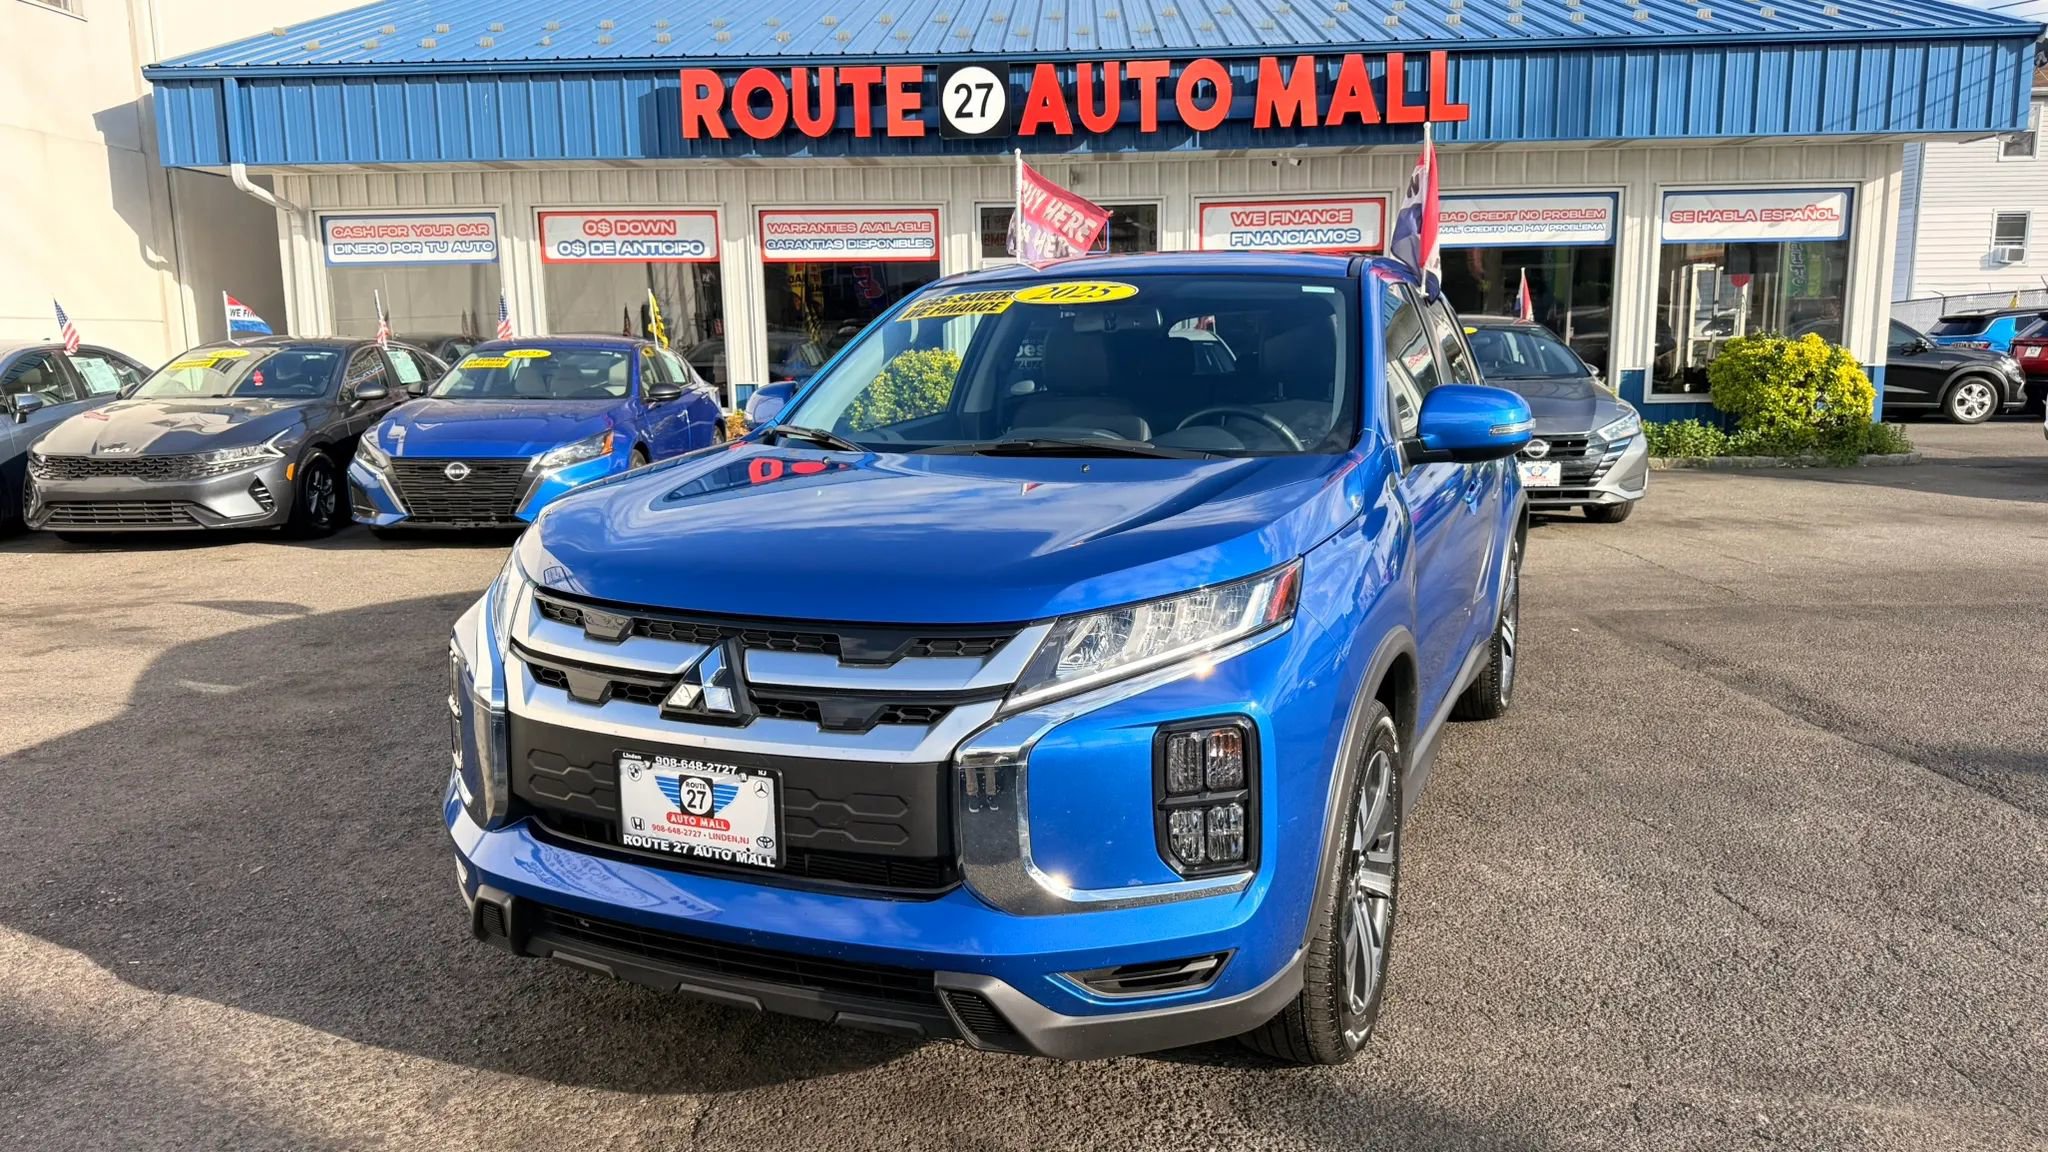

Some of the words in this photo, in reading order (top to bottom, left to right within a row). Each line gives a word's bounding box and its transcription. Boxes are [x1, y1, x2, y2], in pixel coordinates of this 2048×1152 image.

[680, 65, 926, 140] ROUTE
[953, 82, 995, 119] 27
[1018, 58, 1232, 136] AUTO
[1253, 50, 1469, 129] MALL
[1042, 198, 1098, 243] HERE
[1231, 211, 1266, 226] WE
[1268, 209, 1353, 225] FINANCE
[1439, 212, 1467, 222] BAD
[1469, 211, 1517, 222] CREDIT
[1519, 210, 1540, 220] NO
[1542, 209, 1606, 220] PROBLEM
[1670, 210, 1696, 223] SE
[1697, 209, 1757, 223] HABLA
[1760, 204, 1840, 222] ESPAÑOL
[332, 226, 375, 238] CASH
[378, 225, 408, 238] FOR
[412, 224, 453, 237] YOUR
[457, 223, 489, 236] CAR
[615, 220, 676, 235] DOWN
[767, 222, 857, 234] WARRANTIES
[860, 222, 931, 233] AVAILABLE
[1439, 225, 1461, 234] MAL
[1463, 224, 1506, 234] CREDITO
[1507, 224, 1523, 233] NO
[1524, 224, 1547, 233] HAY
[1548, 223, 1604, 232] PROBLEMA
[765, 239, 844, 250] GARANTIAS
[846, 238, 933, 249] DISPONIBLES
[1230, 228, 1361, 246] FINANCIAMOS
[334, 243, 388, 255] DINERO
[391, 242, 422, 254] POR
[425, 242, 448, 253] TU
[452, 241, 494, 253] AUTO
[589, 240, 616, 256] DE
[618, 240, 704, 256] ANTICIPO
[1027, 285, 1121, 300] 2025
[230, 308, 241, 317] WE
[926, 301, 1007, 317] FINANCE
[622, 752, 642, 760] Linden
[655, 756, 738, 775] 908-648-2727
[685, 781, 707, 790] ROUTE
[686, 789, 707, 810] 27
[670, 813, 697, 826] AUTO
[699, 817, 728, 830] MALL
[652, 823, 702, 838] 908-648-2727
[623, 834, 670, 852] ROUTE
[673, 841, 689, 854] 27
[693, 843, 733, 861] AUTO
[736, 850, 776, 868] MALL
